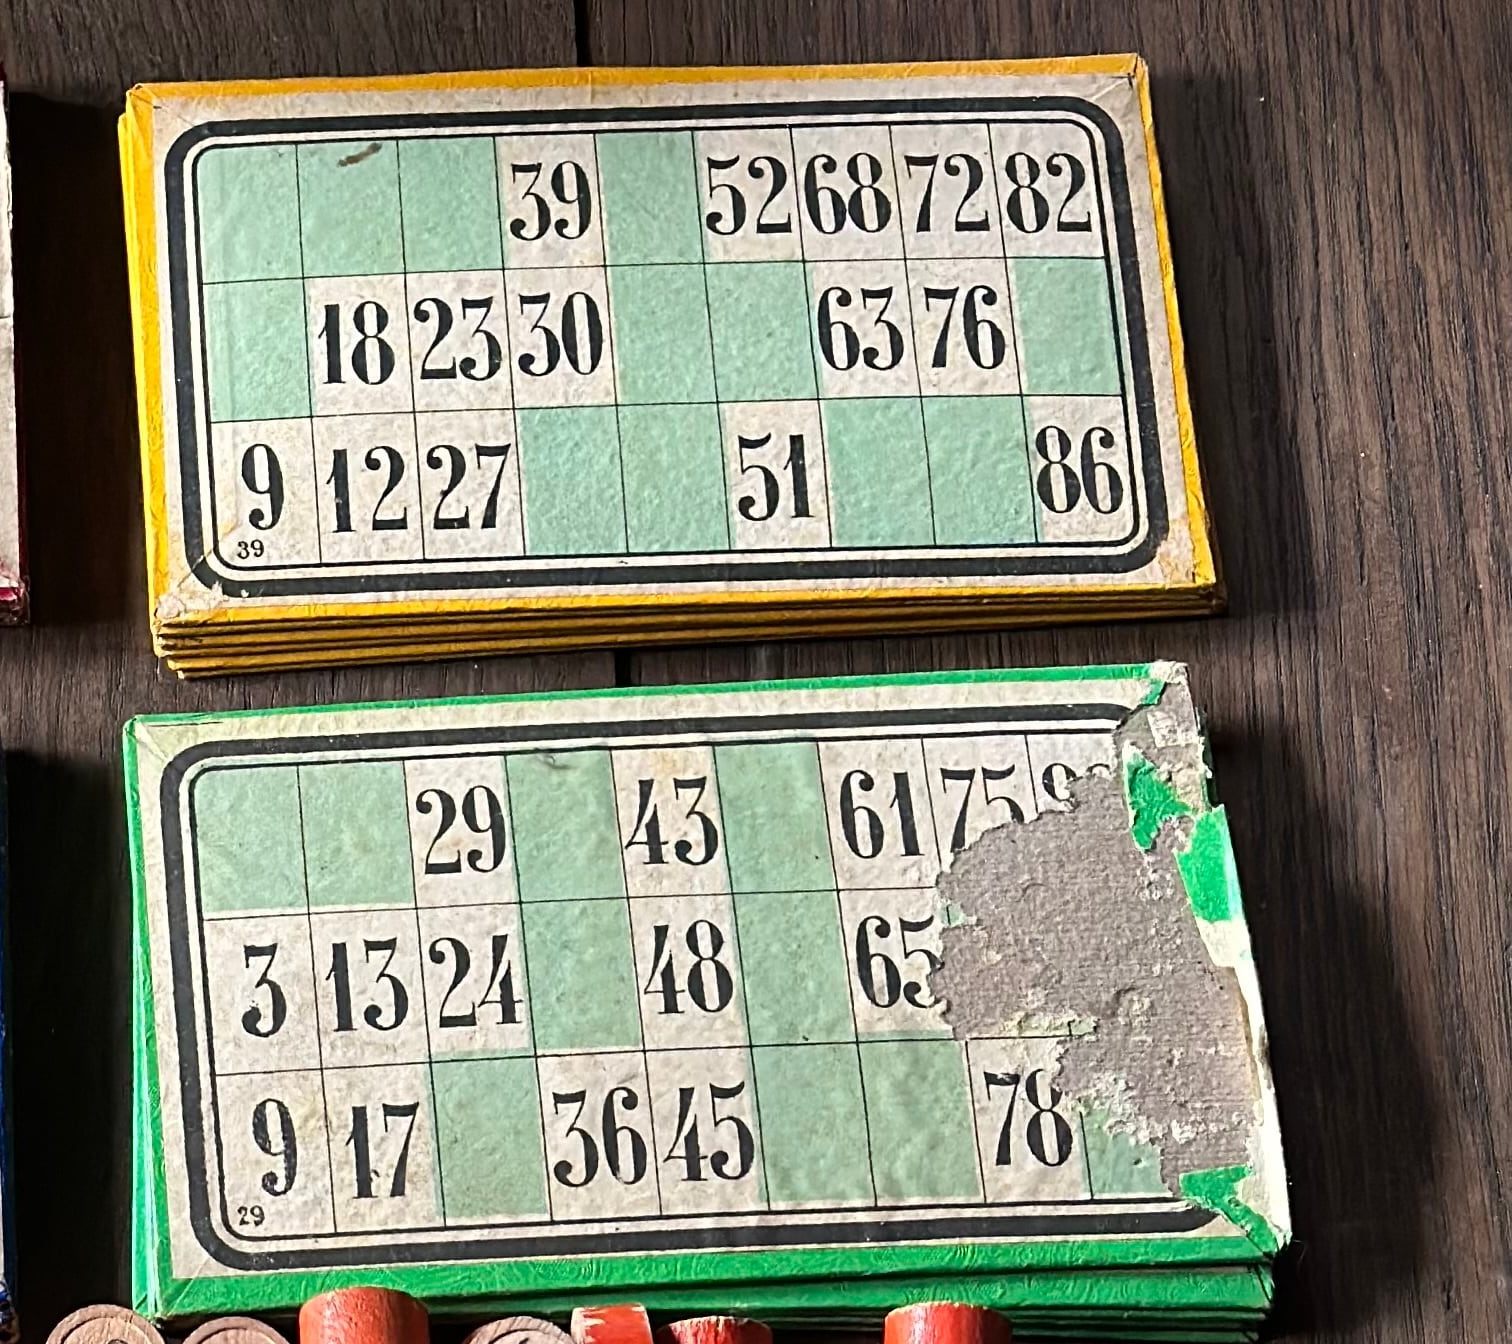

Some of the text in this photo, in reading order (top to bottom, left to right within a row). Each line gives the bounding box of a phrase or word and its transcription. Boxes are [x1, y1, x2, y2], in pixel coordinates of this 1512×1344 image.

[510, 152, 1092, 241] 39 52 68 72 82
[318, 285, 1005, 385] 18 23 30 63 76
[242, 426, 1123, 533] 9 12 27 51 86
[237, 539, 264, 559] 39
[416, 785, 505, 874] 29
[625, 776, 718, 866] 43
[840, 770, 924, 859] 61
[242, 915, 947, 1038] 3 13 24 48 65
[252, 1069, 1073, 1199] 9 17 36 45 78
[238, 1205, 265, 1226] 29
